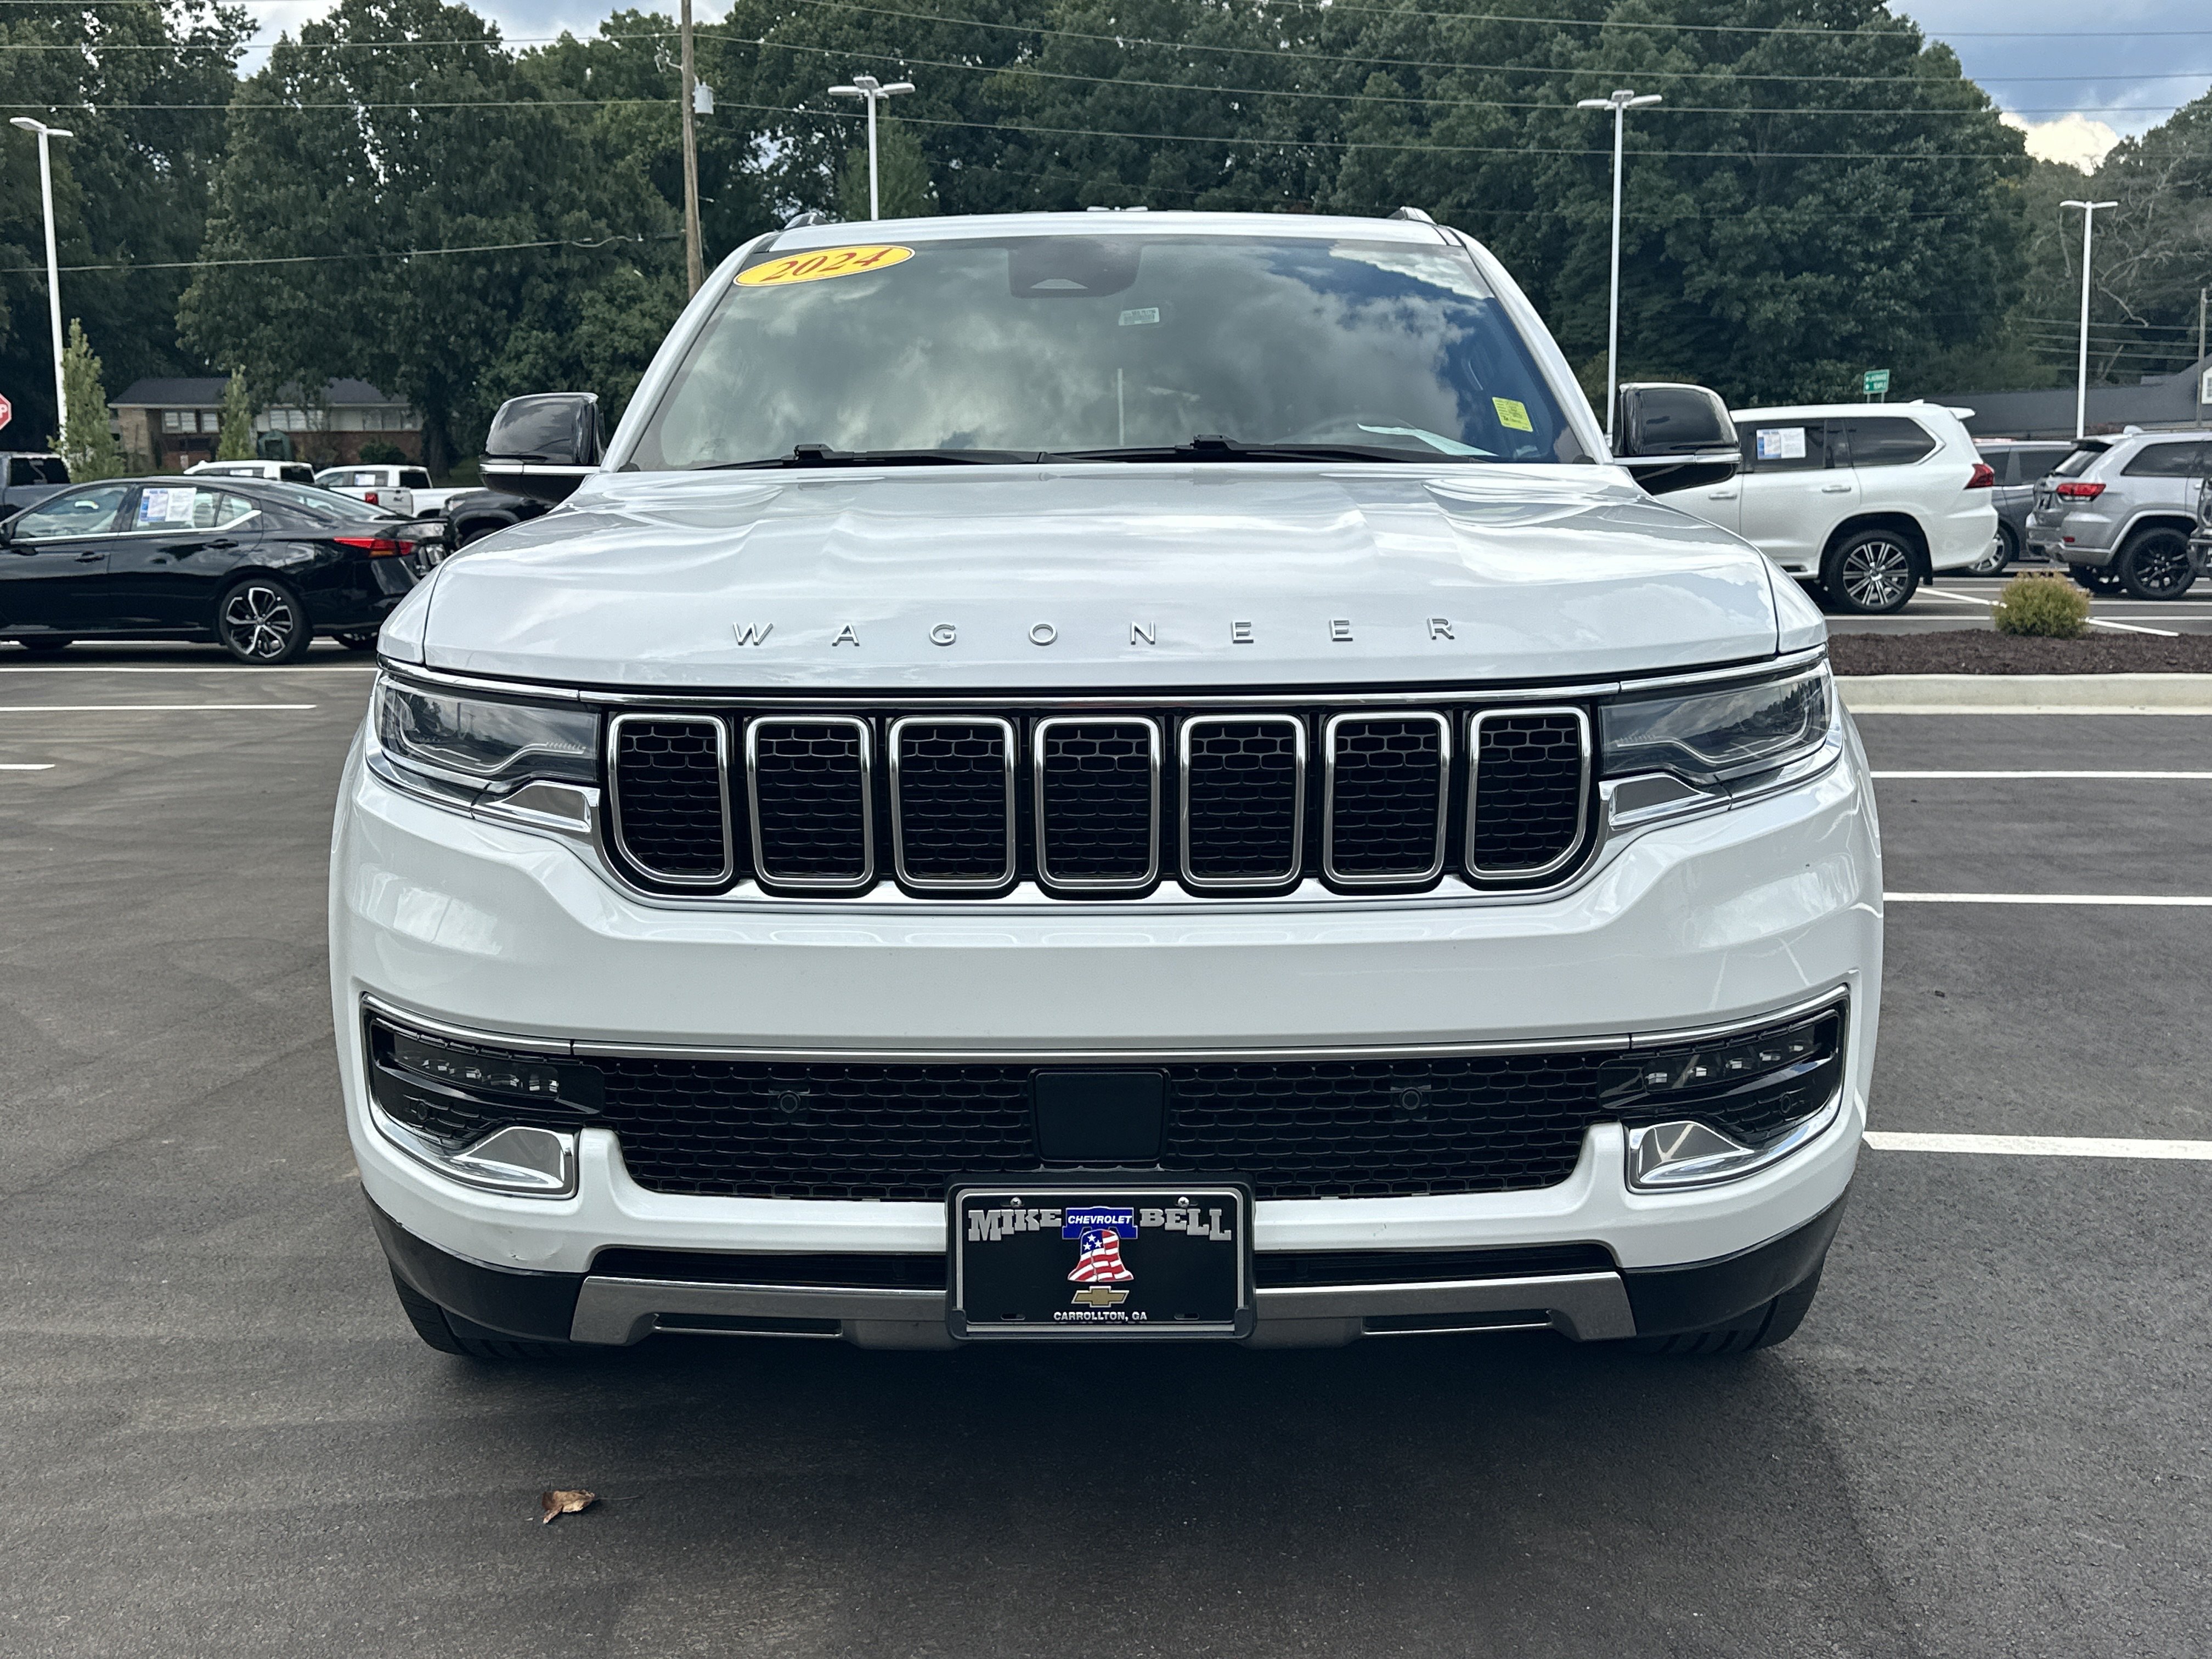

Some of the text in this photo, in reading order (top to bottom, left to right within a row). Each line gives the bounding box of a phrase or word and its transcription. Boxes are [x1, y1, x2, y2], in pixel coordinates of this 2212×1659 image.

[759, 247, 895, 283] 2024
[732, 617, 1455, 647] WAGONEER
[968, 1208, 1232, 1242] MIKE BELL
[1068, 1215, 1133, 1224] CHEVROLET
[1053, 1311, 1148, 1322] CARROLLTON, GA
